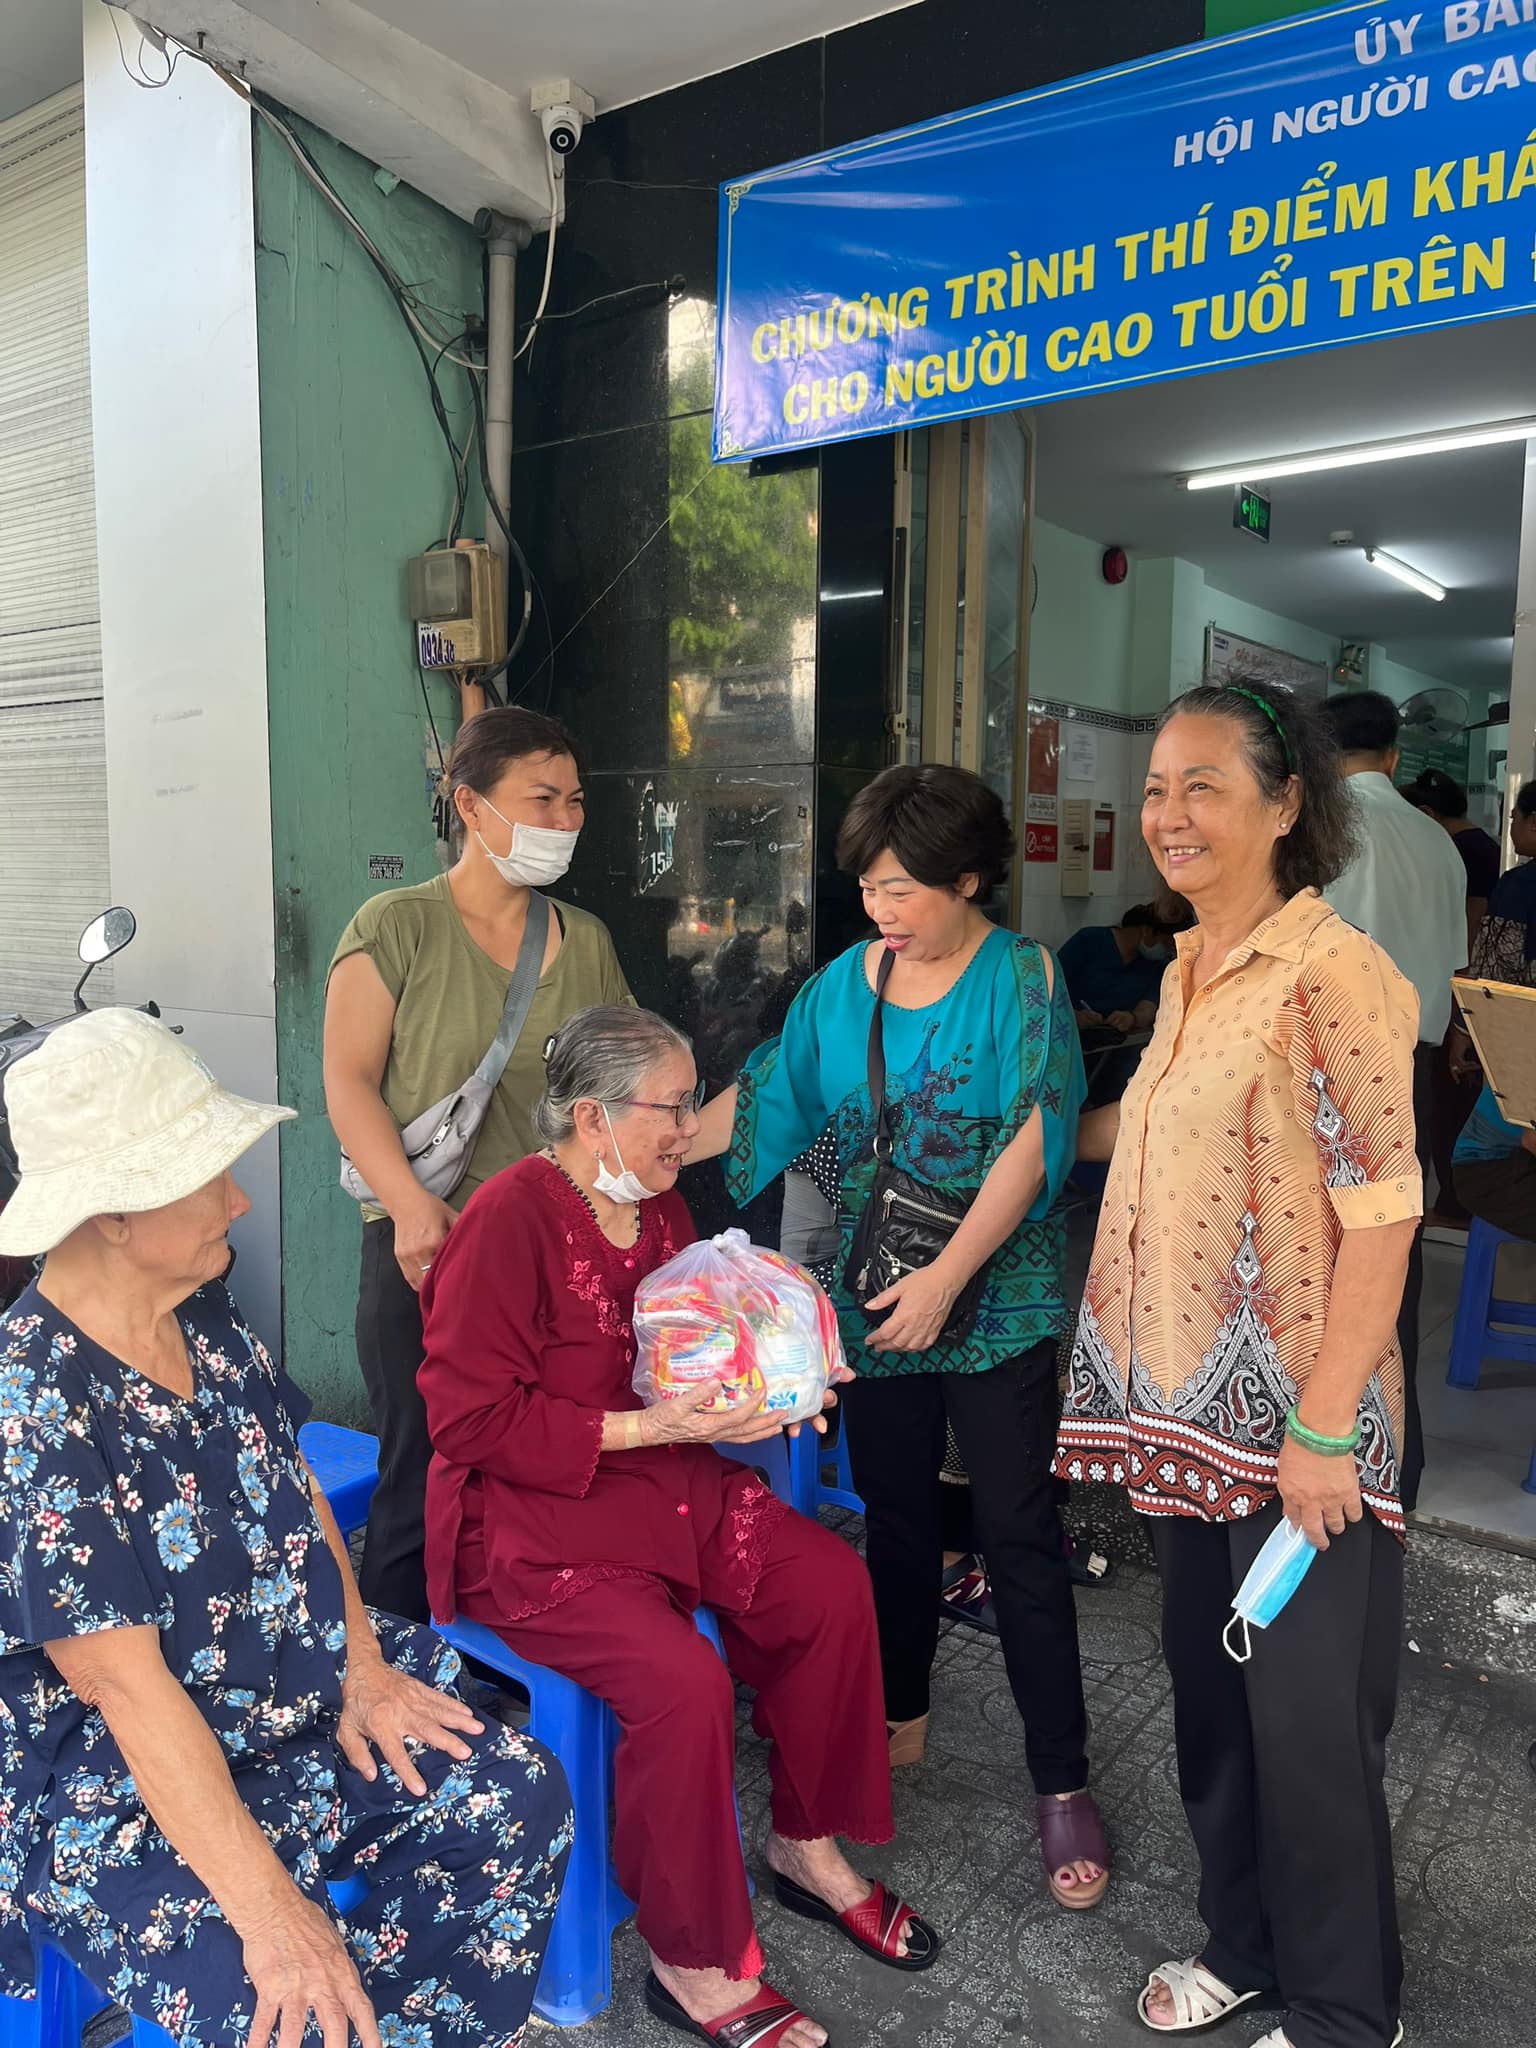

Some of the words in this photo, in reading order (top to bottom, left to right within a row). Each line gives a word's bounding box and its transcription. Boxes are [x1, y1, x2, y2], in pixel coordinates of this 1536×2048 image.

[1354, 17, 1421, 65] ỦY
[1174, 116, 1253, 167] HỘI
[1272, 77, 1428, 143] NGƯỜI
[752, 286, 929, 362] CHƯƠNG
[945, 245, 1095, 318] TRÌNH
[1115, 204, 1211, 280] THÍ
[1229, 162, 1388, 255] ĐIỂM
[783, 372, 868, 424] CHO
[885, 329, 1027, 407] NGƯỜI
[1045, 313, 1152, 372] CAO
[1173, 254, 1307, 347] TUỔI
[1330, 235, 1505, 318] TRÊN
